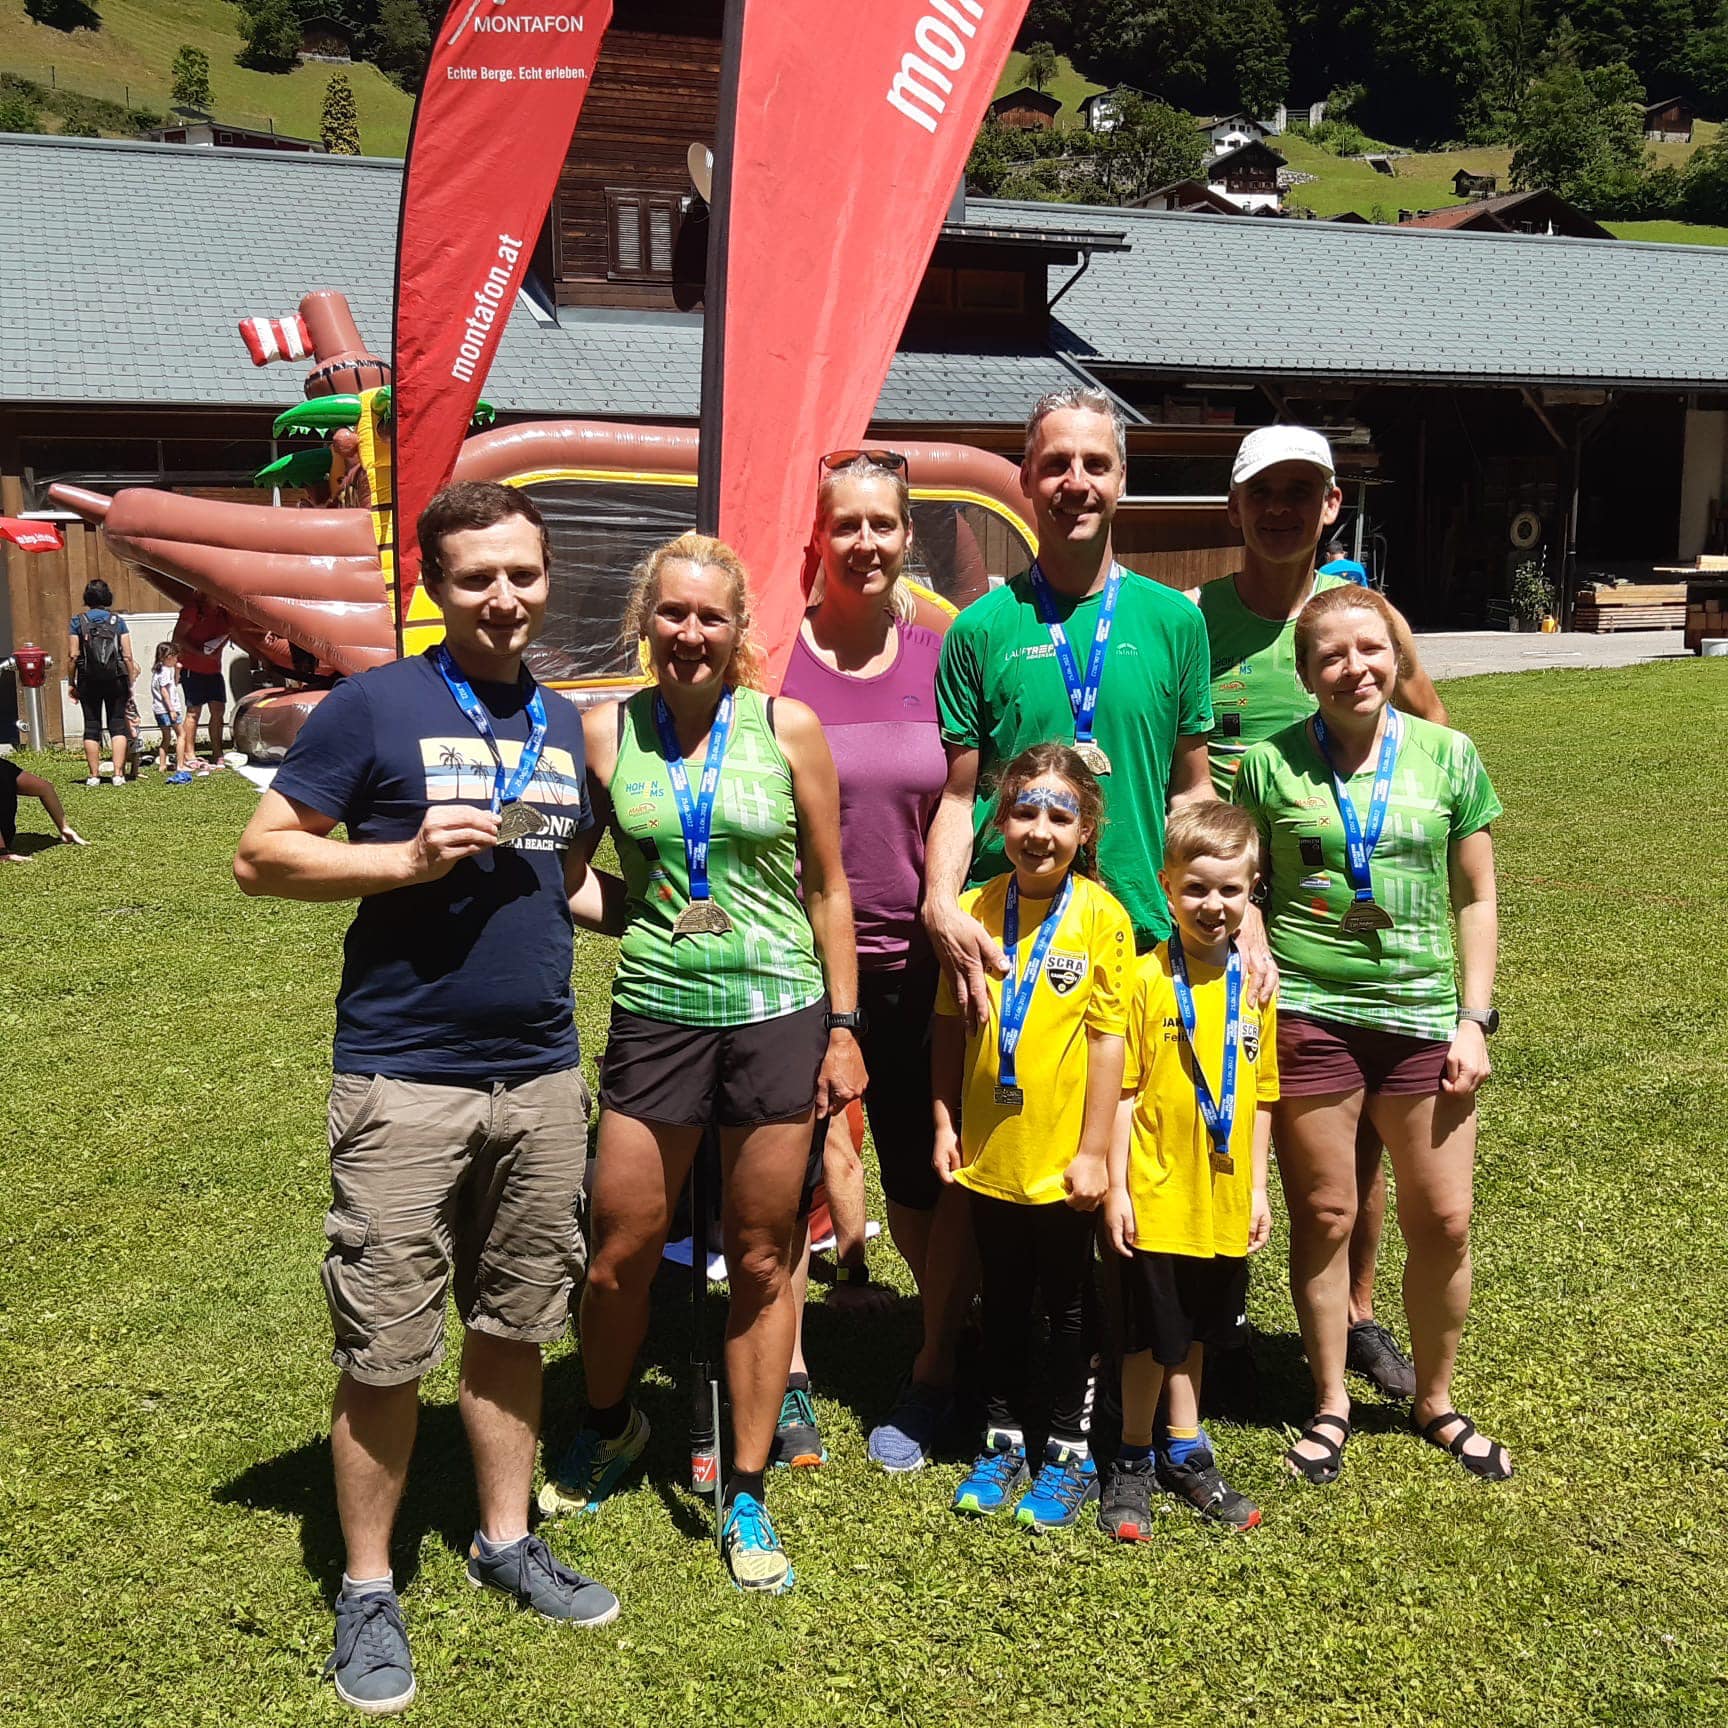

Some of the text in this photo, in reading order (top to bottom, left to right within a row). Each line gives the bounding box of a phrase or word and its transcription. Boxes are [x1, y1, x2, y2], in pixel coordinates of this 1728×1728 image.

[474, 15, 584, 33] MONTAFON
[447, 66, 587, 82] Echte Berge. Echt erleben.
[451, 233, 523, 383] montafon.at
[525, 838, 554, 851] BEACH
[1046, 956, 1084, 973] SCRA
[1013, 991, 1028, 1020] 25.06.2022
[1179, 988, 1191, 1018] 25.06.2022
